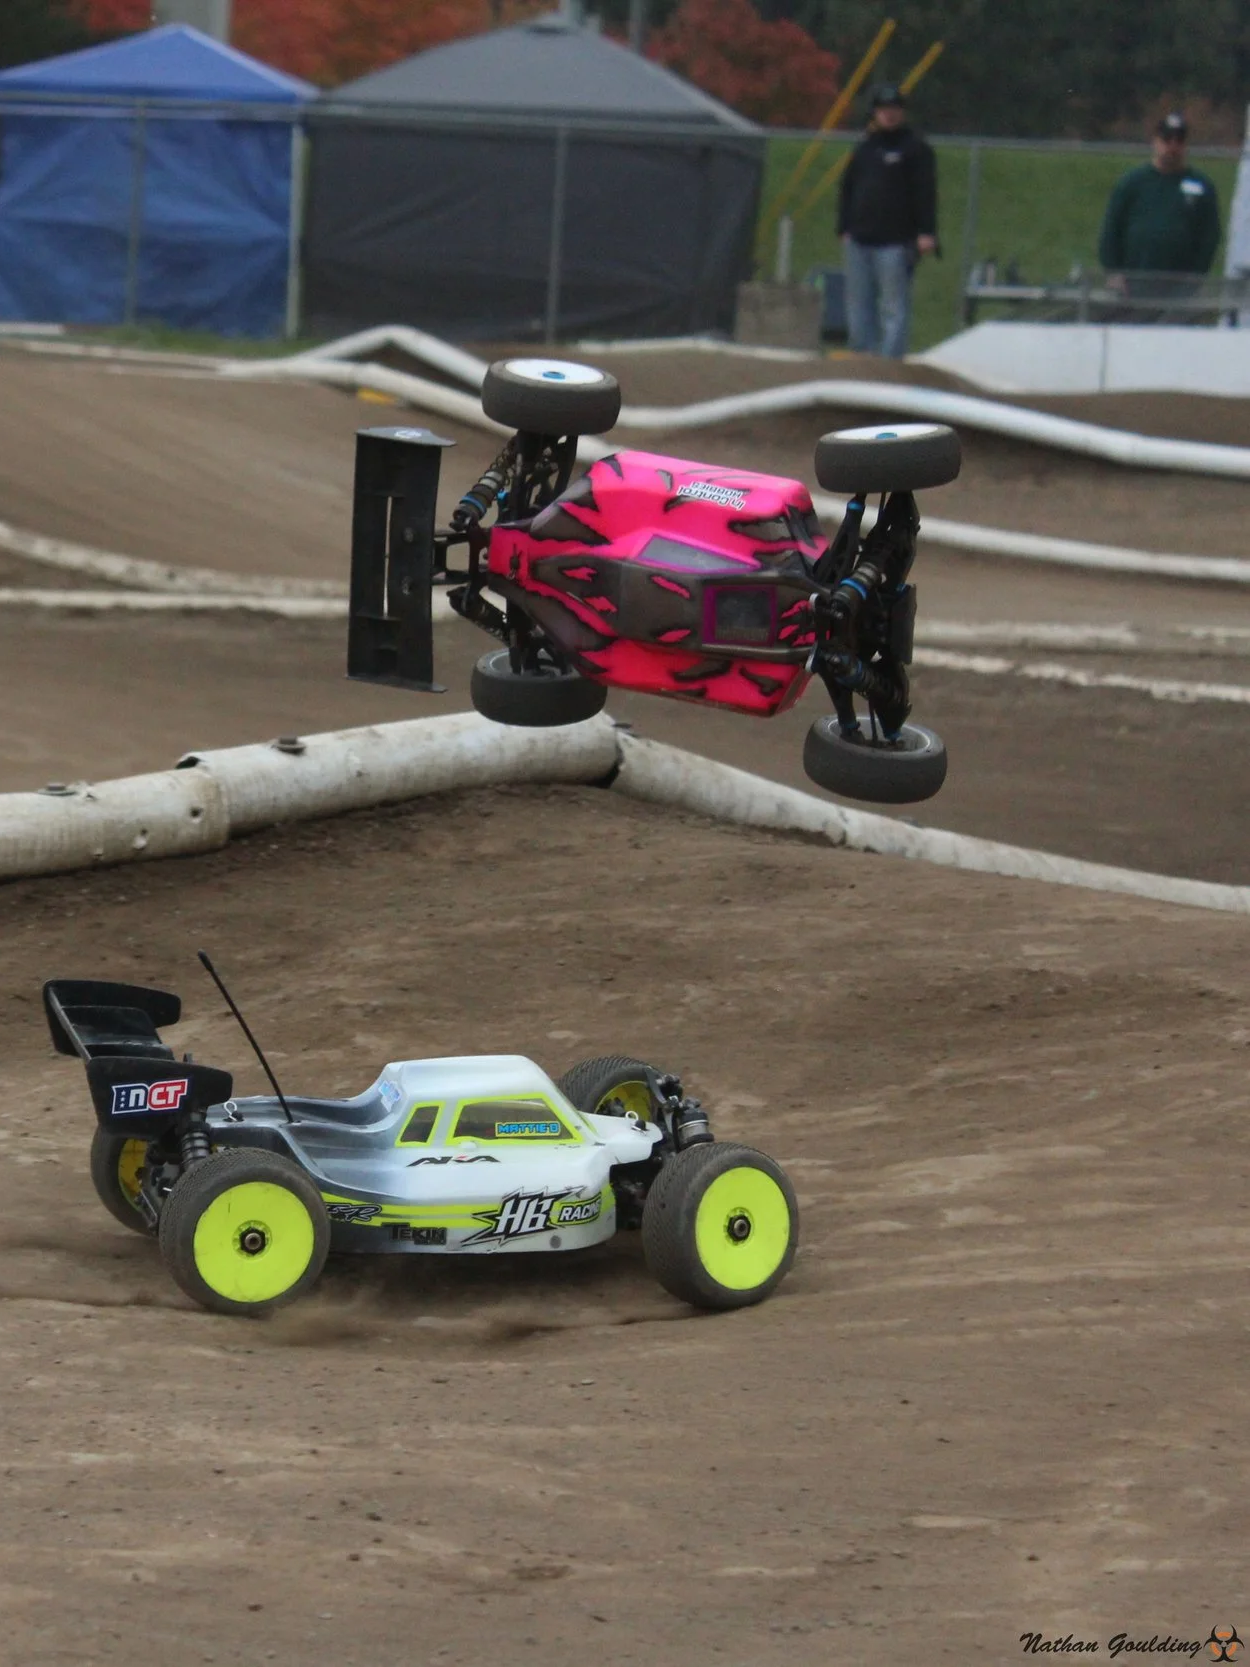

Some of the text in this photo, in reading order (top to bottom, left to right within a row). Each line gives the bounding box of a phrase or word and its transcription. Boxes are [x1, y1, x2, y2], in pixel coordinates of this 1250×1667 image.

[677, 484, 746, 511] In Control
[691, 481, 742, 498] HOBBIES
